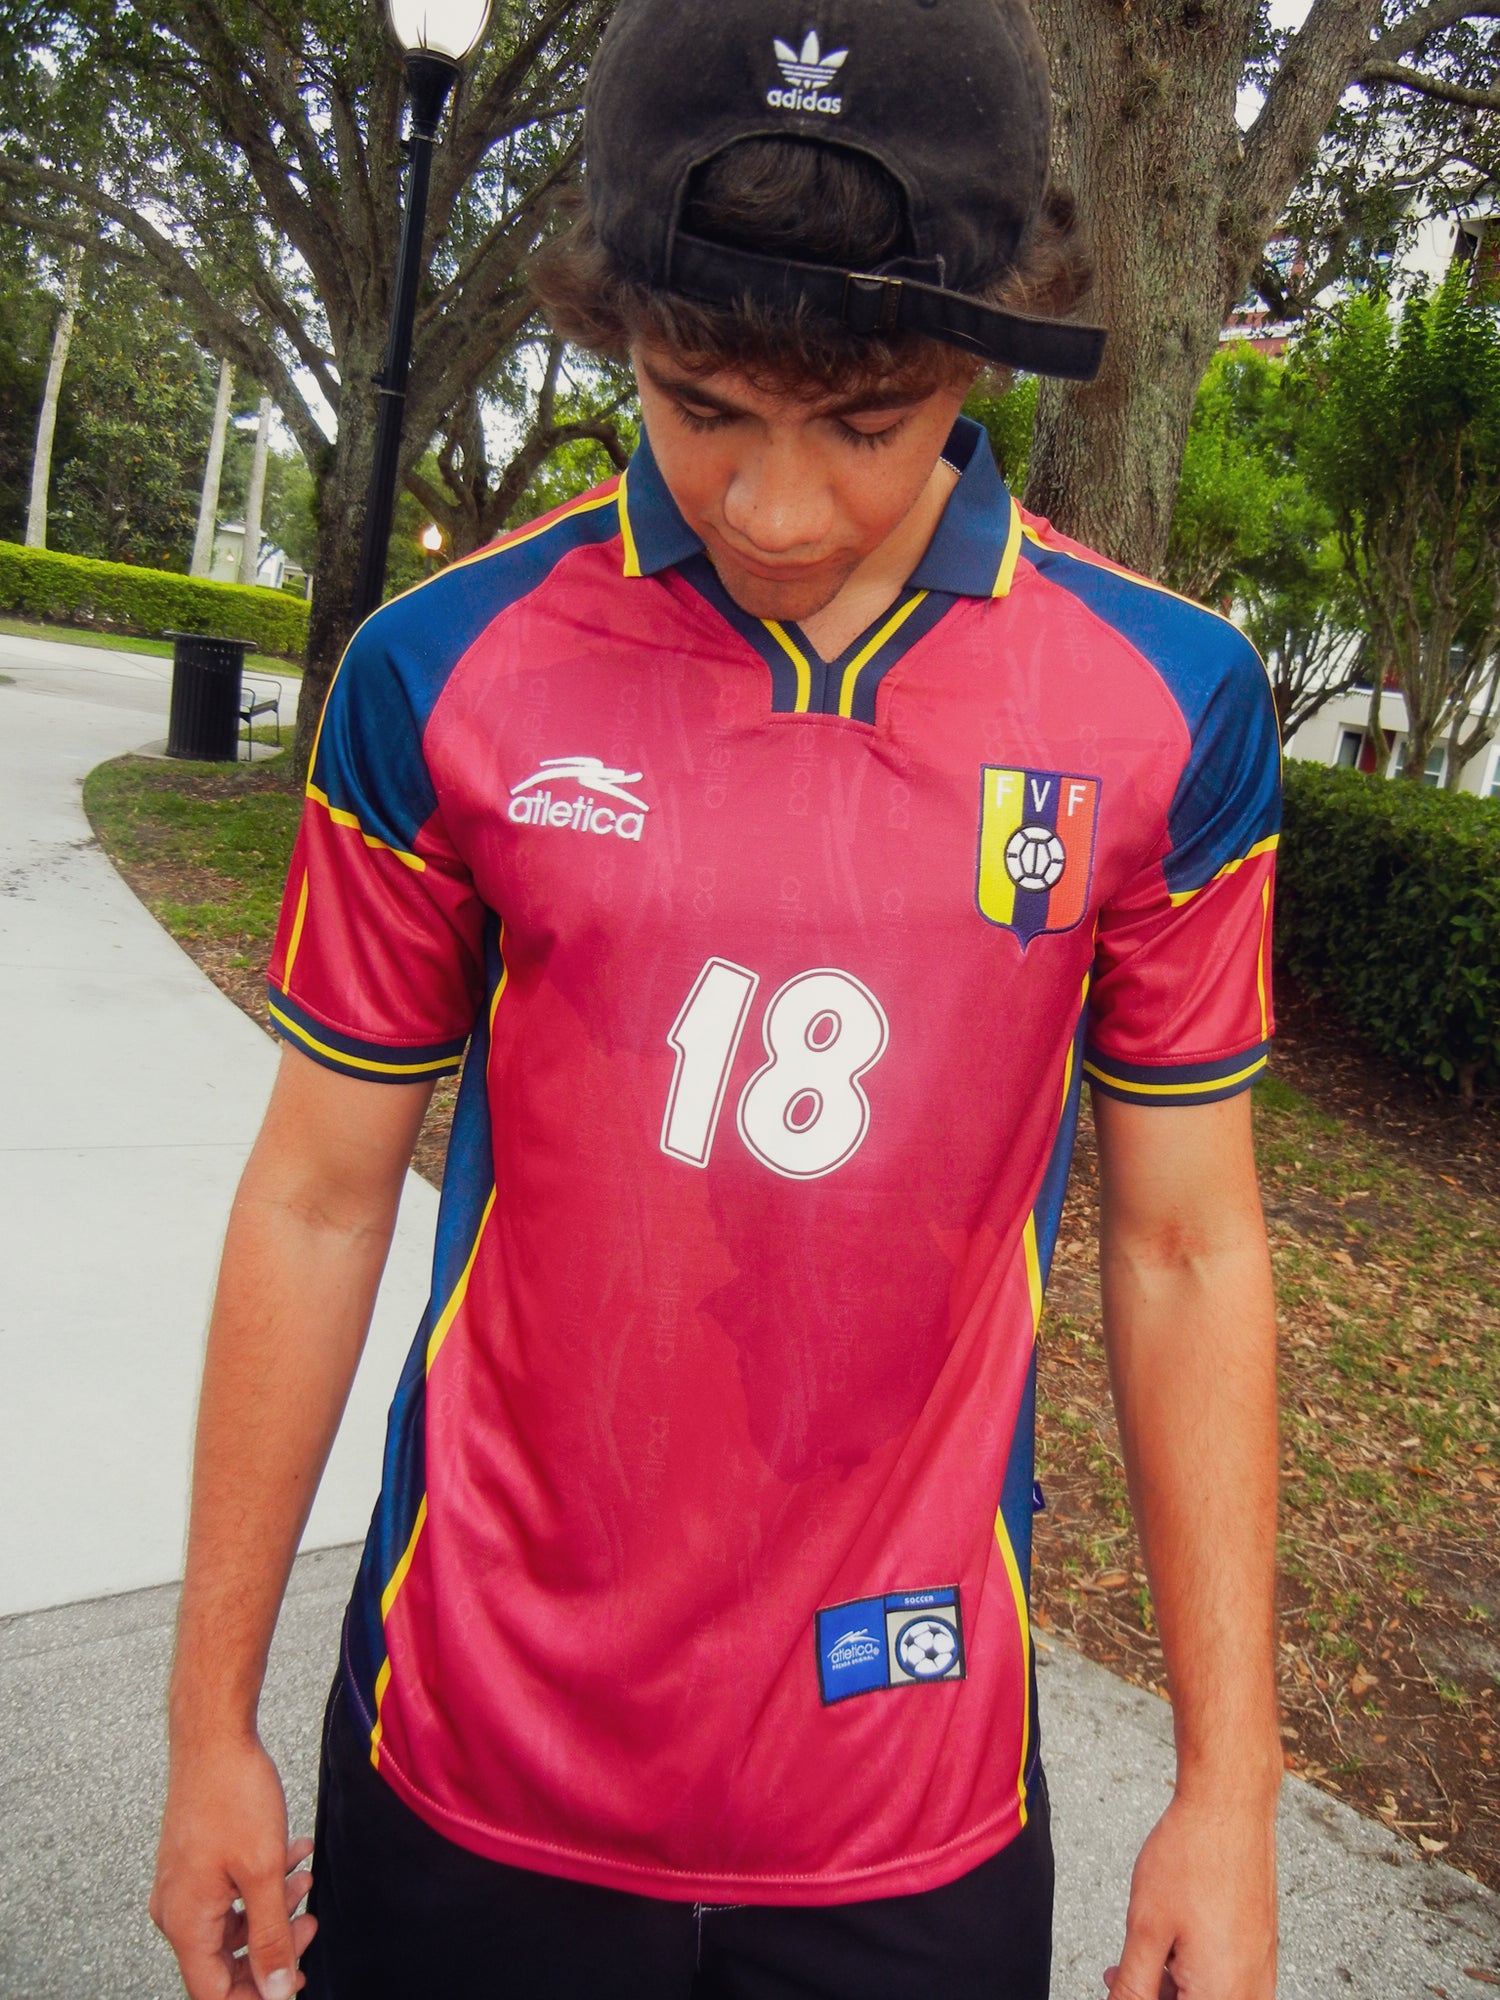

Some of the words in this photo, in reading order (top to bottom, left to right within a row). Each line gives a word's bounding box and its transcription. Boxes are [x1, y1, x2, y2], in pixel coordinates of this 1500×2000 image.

[766, 88, 843, 115] adidas
[508, 789, 646, 842] atletica
[659, 956, 890, 1181] 18
[904, 1595, 934, 1605] SOCCER
[831, 1641, 874, 1664] atletica
